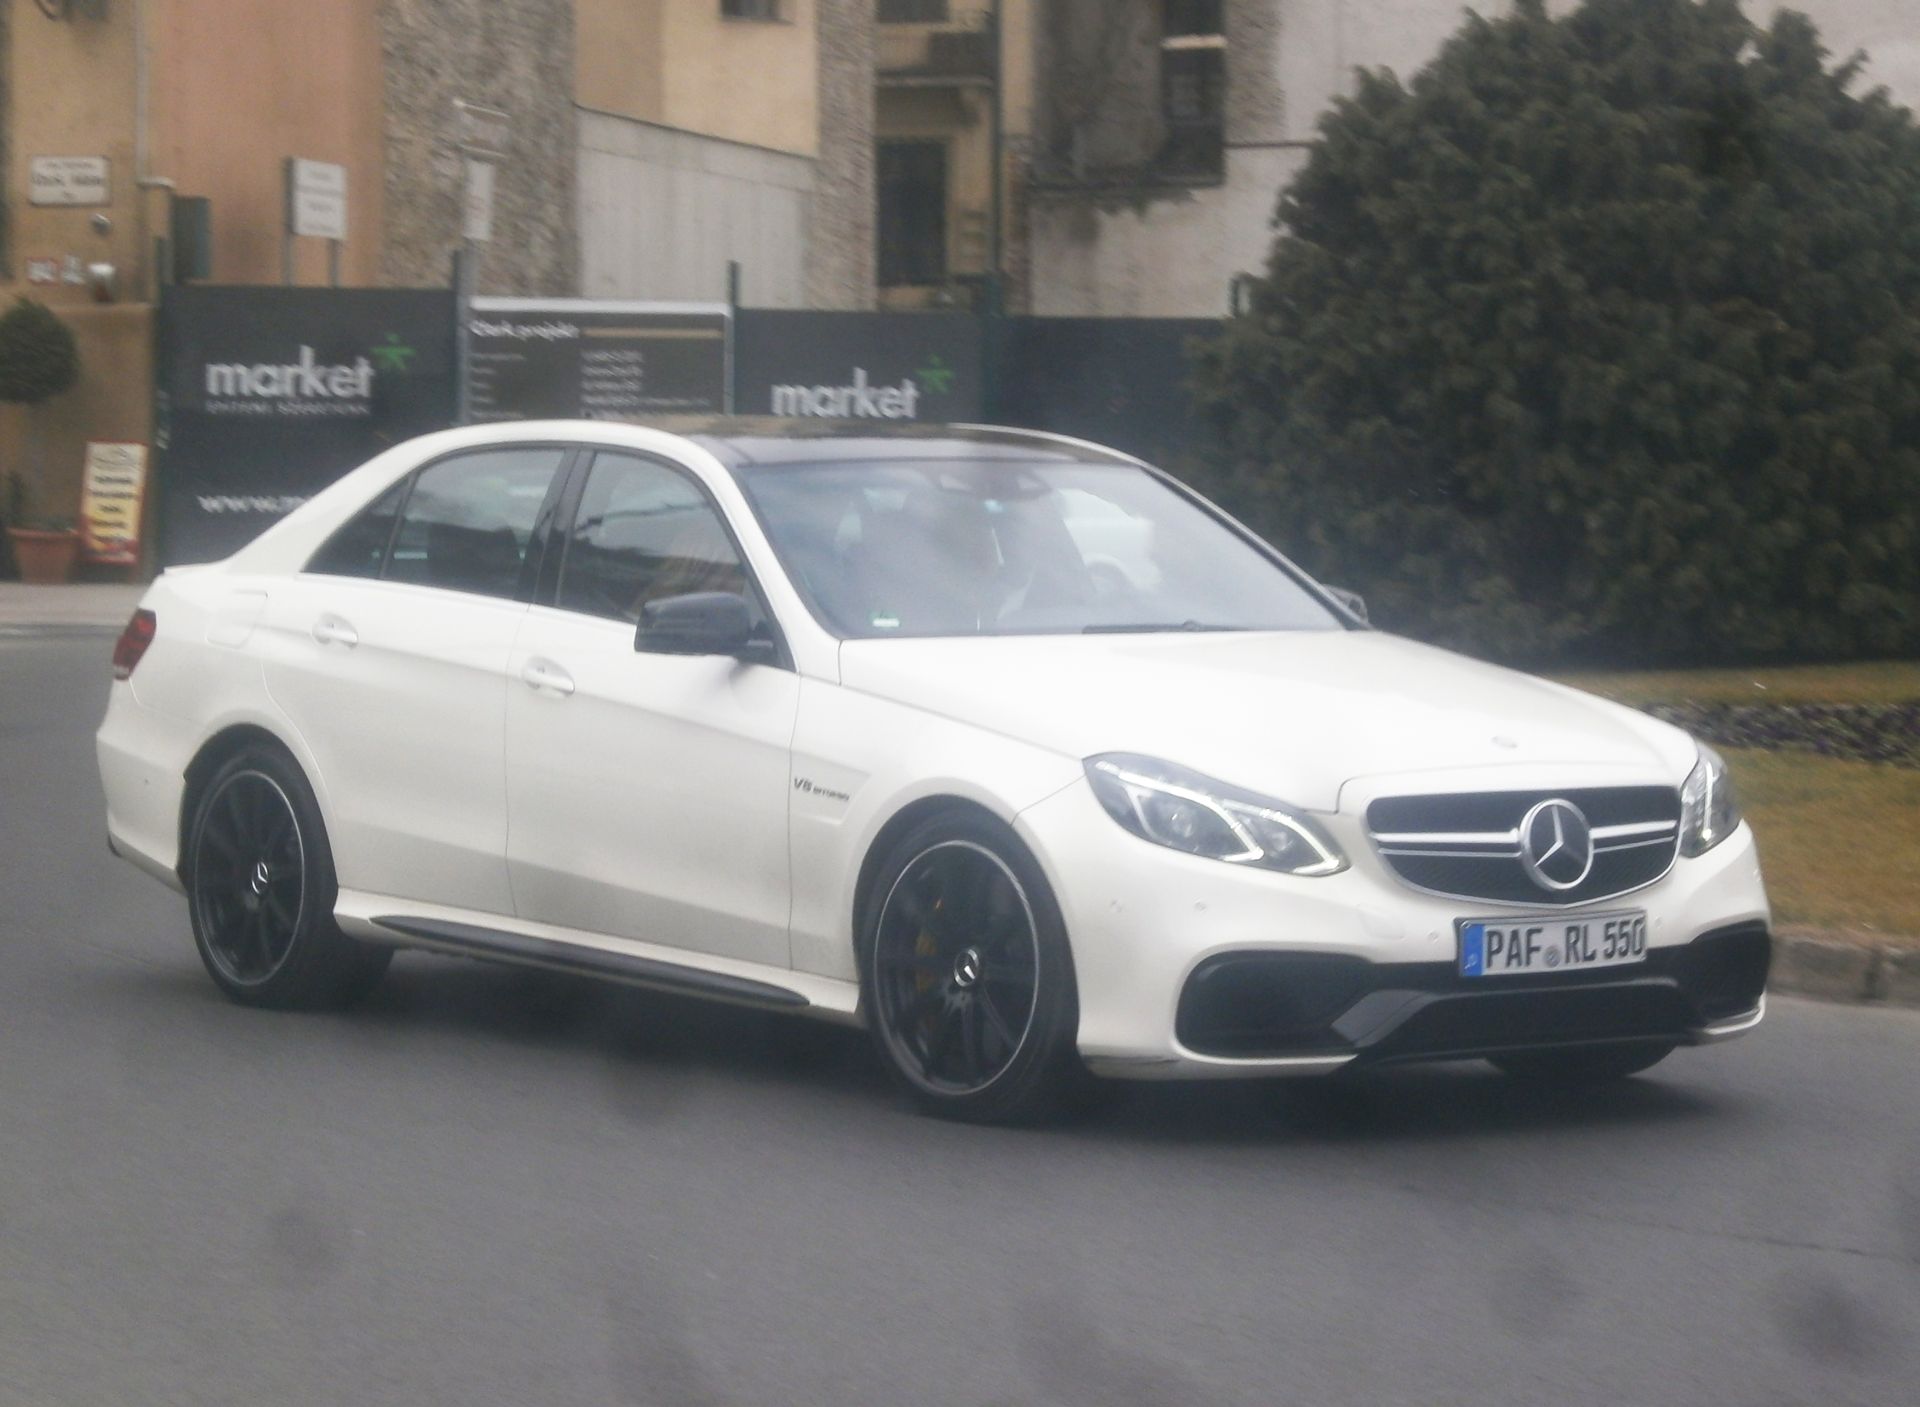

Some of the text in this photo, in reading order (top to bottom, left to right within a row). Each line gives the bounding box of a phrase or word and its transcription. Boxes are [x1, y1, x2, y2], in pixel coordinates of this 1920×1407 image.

[206, 345, 373, 398] market
[772, 366, 919, 418] market
[1486, 914, 1647, 968] PAF RL 550
